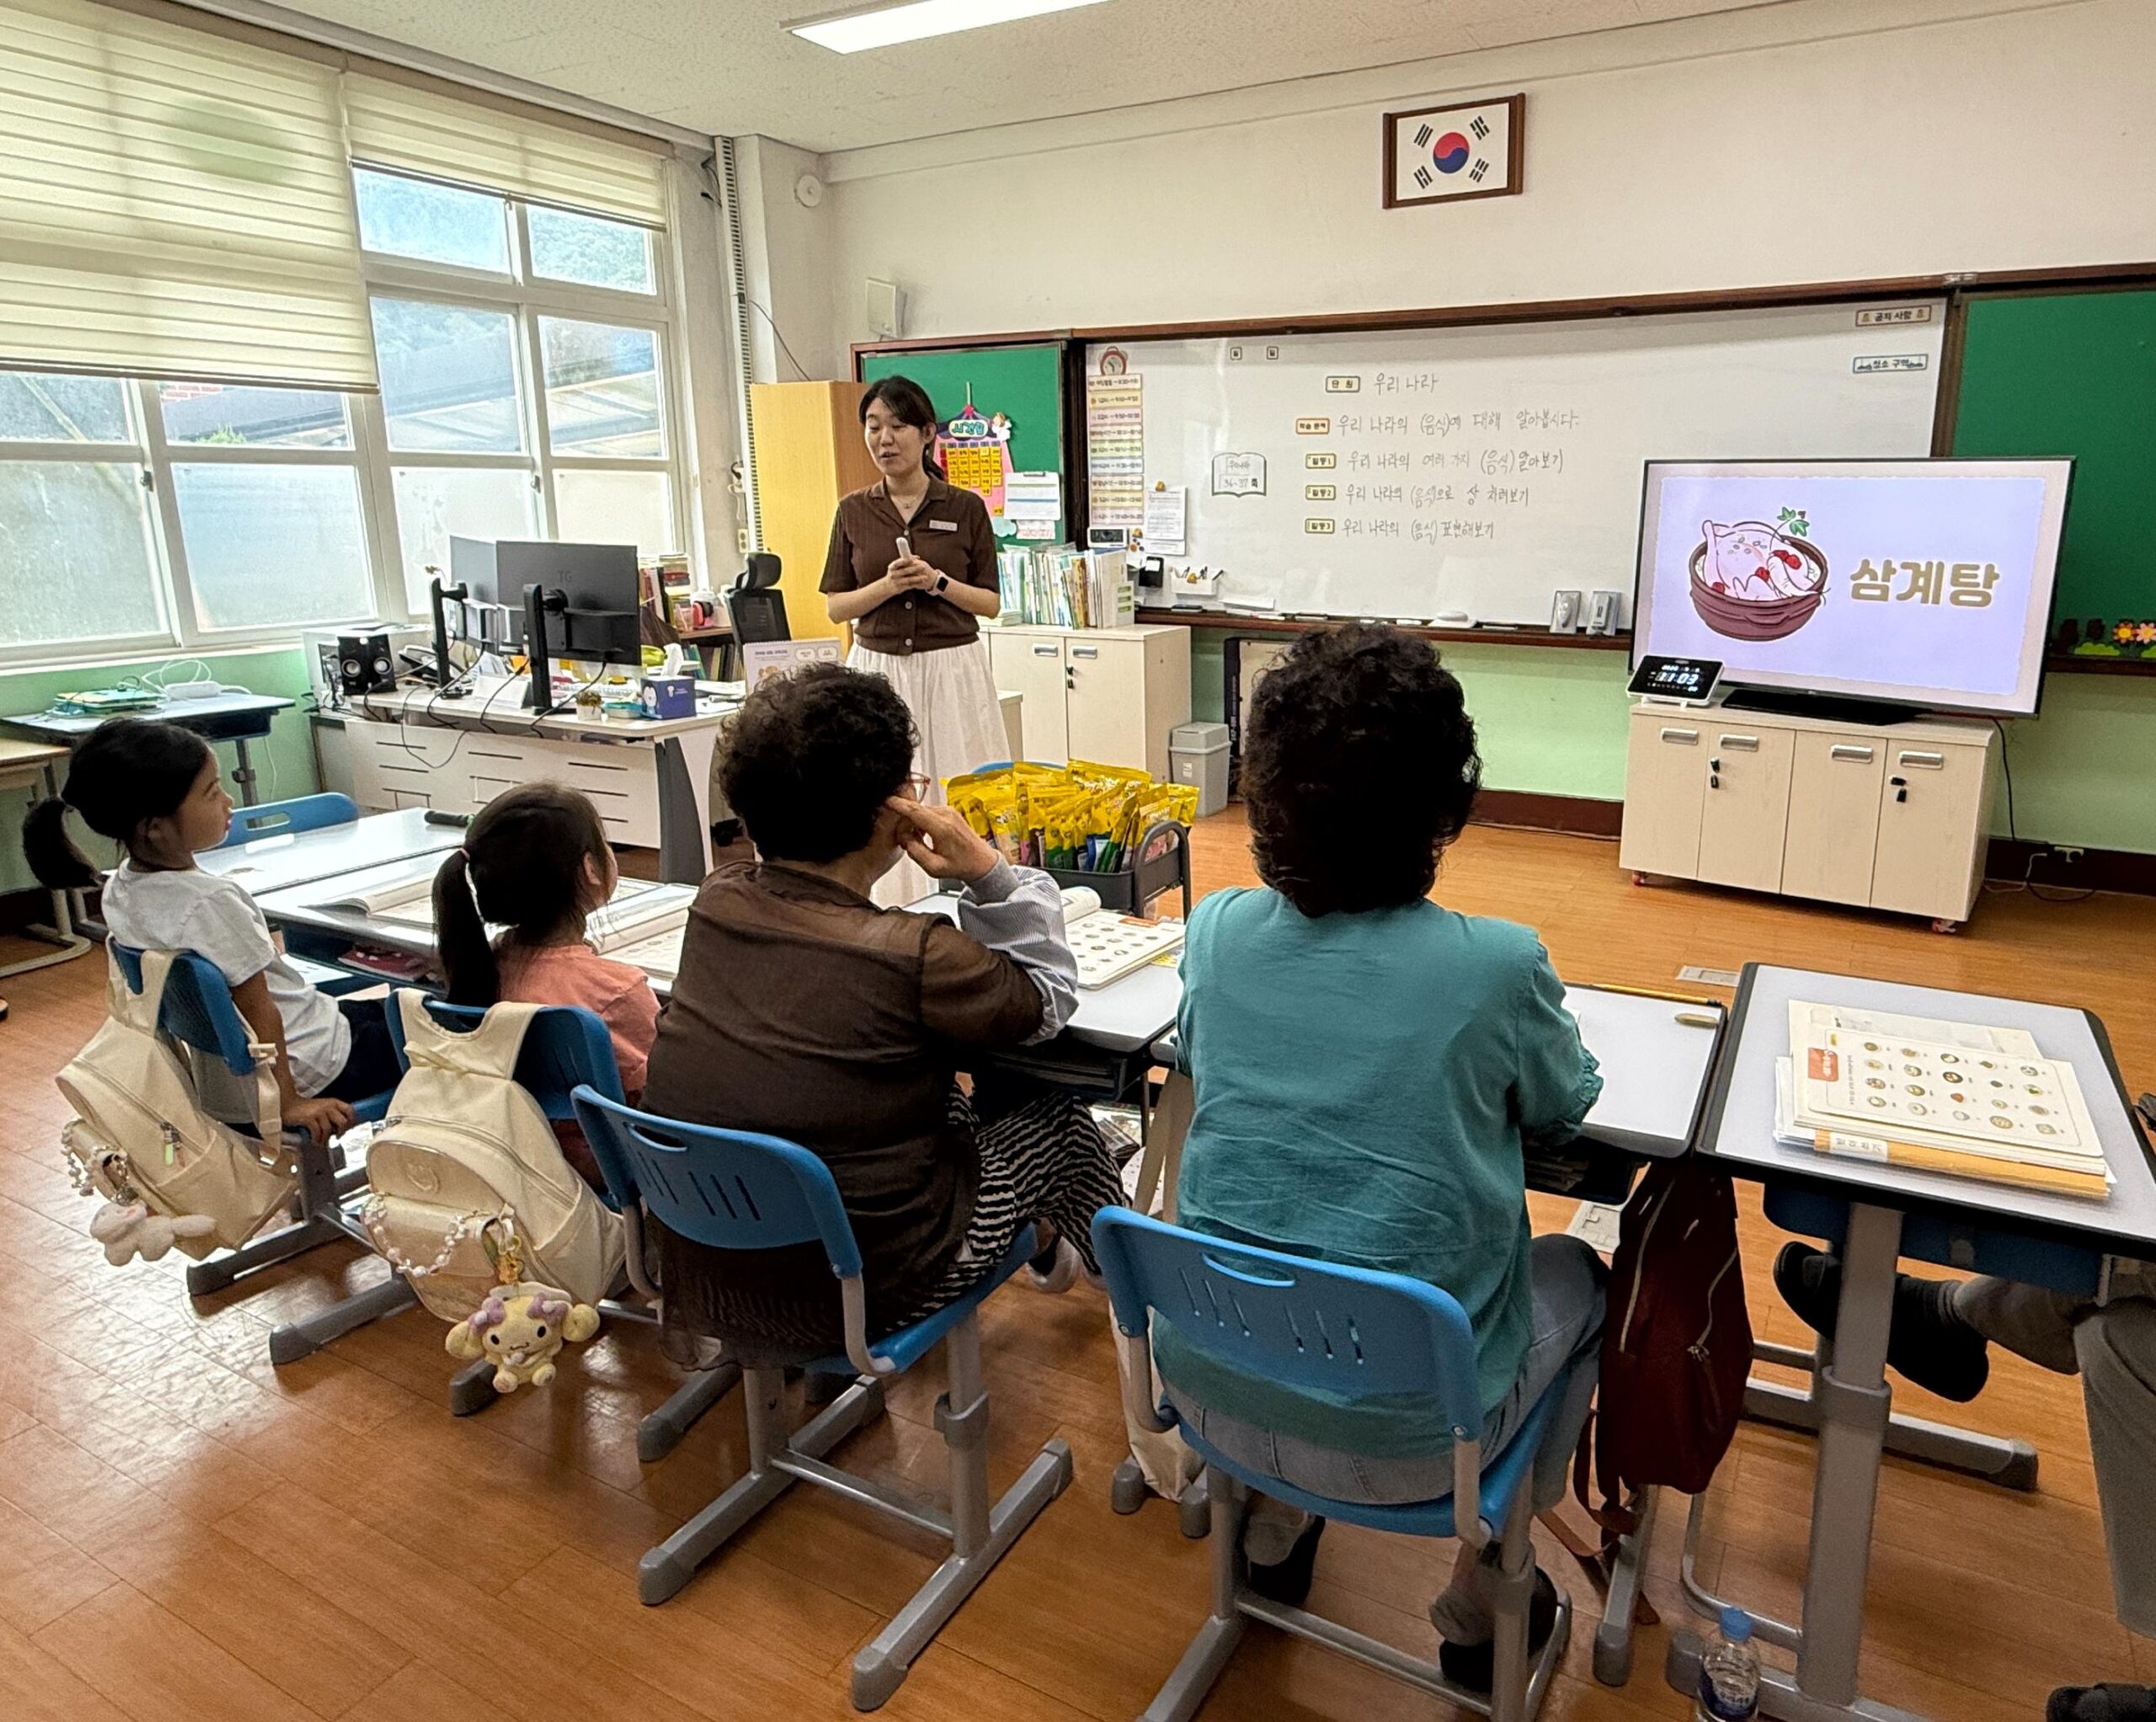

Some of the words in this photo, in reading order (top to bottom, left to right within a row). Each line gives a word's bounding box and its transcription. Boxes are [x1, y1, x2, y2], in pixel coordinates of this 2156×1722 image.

[1374, 372, 1400, 395] 우리
[1406, 373, 1439, 393] 나라
[1337, 415, 1362, 437] 우리
[1370, 415, 1408, 434] 나라의
[1473, 412, 1502, 430] 대해
[1348, 450, 1370, 471] 우리
[1377, 452, 1410, 471] 나라의
[1346, 483, 1366, 505] 우리
[1373, 486, 1402, 503] 나라의
[1341, 518, 1363, 539] 우리
[1369, 520, 1399, 536] 나라의
[1850, 558, 2000, 608] 삼계탕
